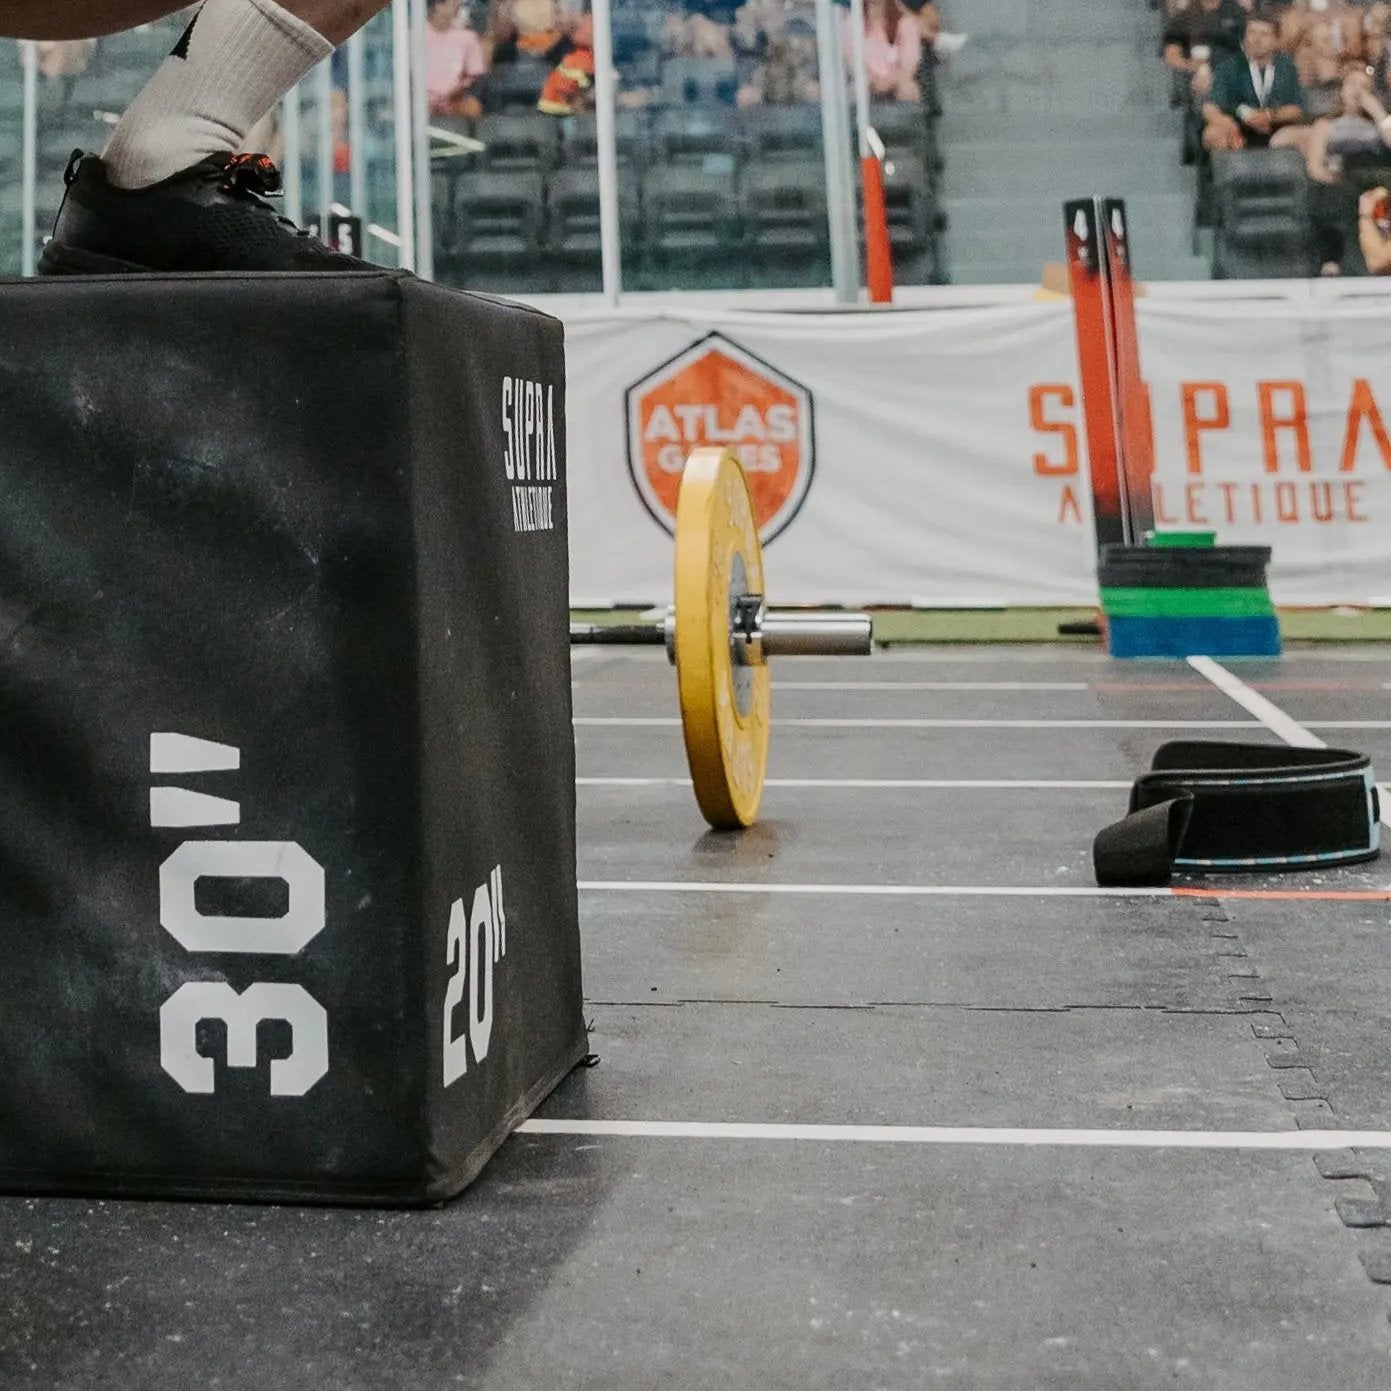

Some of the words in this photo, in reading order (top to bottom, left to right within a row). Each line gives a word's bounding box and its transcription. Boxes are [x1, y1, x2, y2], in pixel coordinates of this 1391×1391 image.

[502, 376, 557, 480] SUPRA
[644, 404, 798, 443] ATLAS
[658, 443, 783, 475] GES
[1028, 378, 1391, 476] SPRA
[1058, 481, 1369, 524] ALETIQUE
[150, 732, 329, 1096] 30"
[443, 864, 506, 1088] 20"
